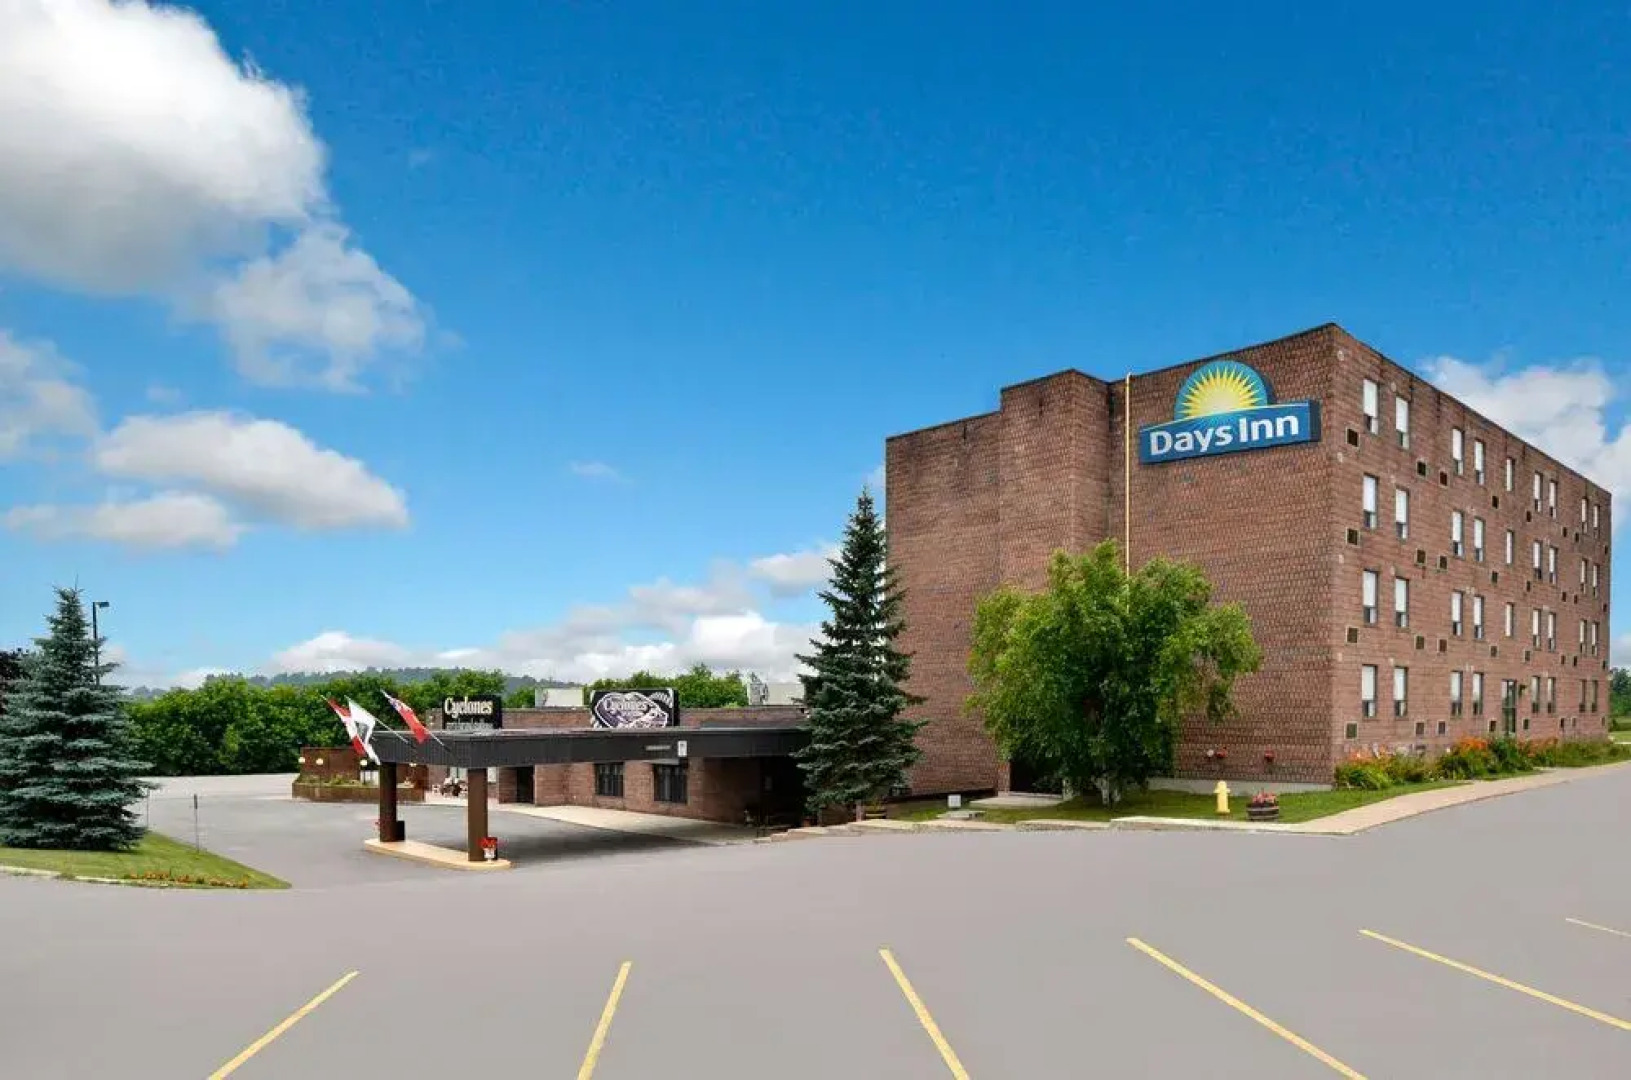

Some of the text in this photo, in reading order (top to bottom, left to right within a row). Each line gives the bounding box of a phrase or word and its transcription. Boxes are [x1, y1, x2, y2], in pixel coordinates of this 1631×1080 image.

[1149, 414, 1299, 456] Days Inn
[444, 696, 493, 719] Cyclones
